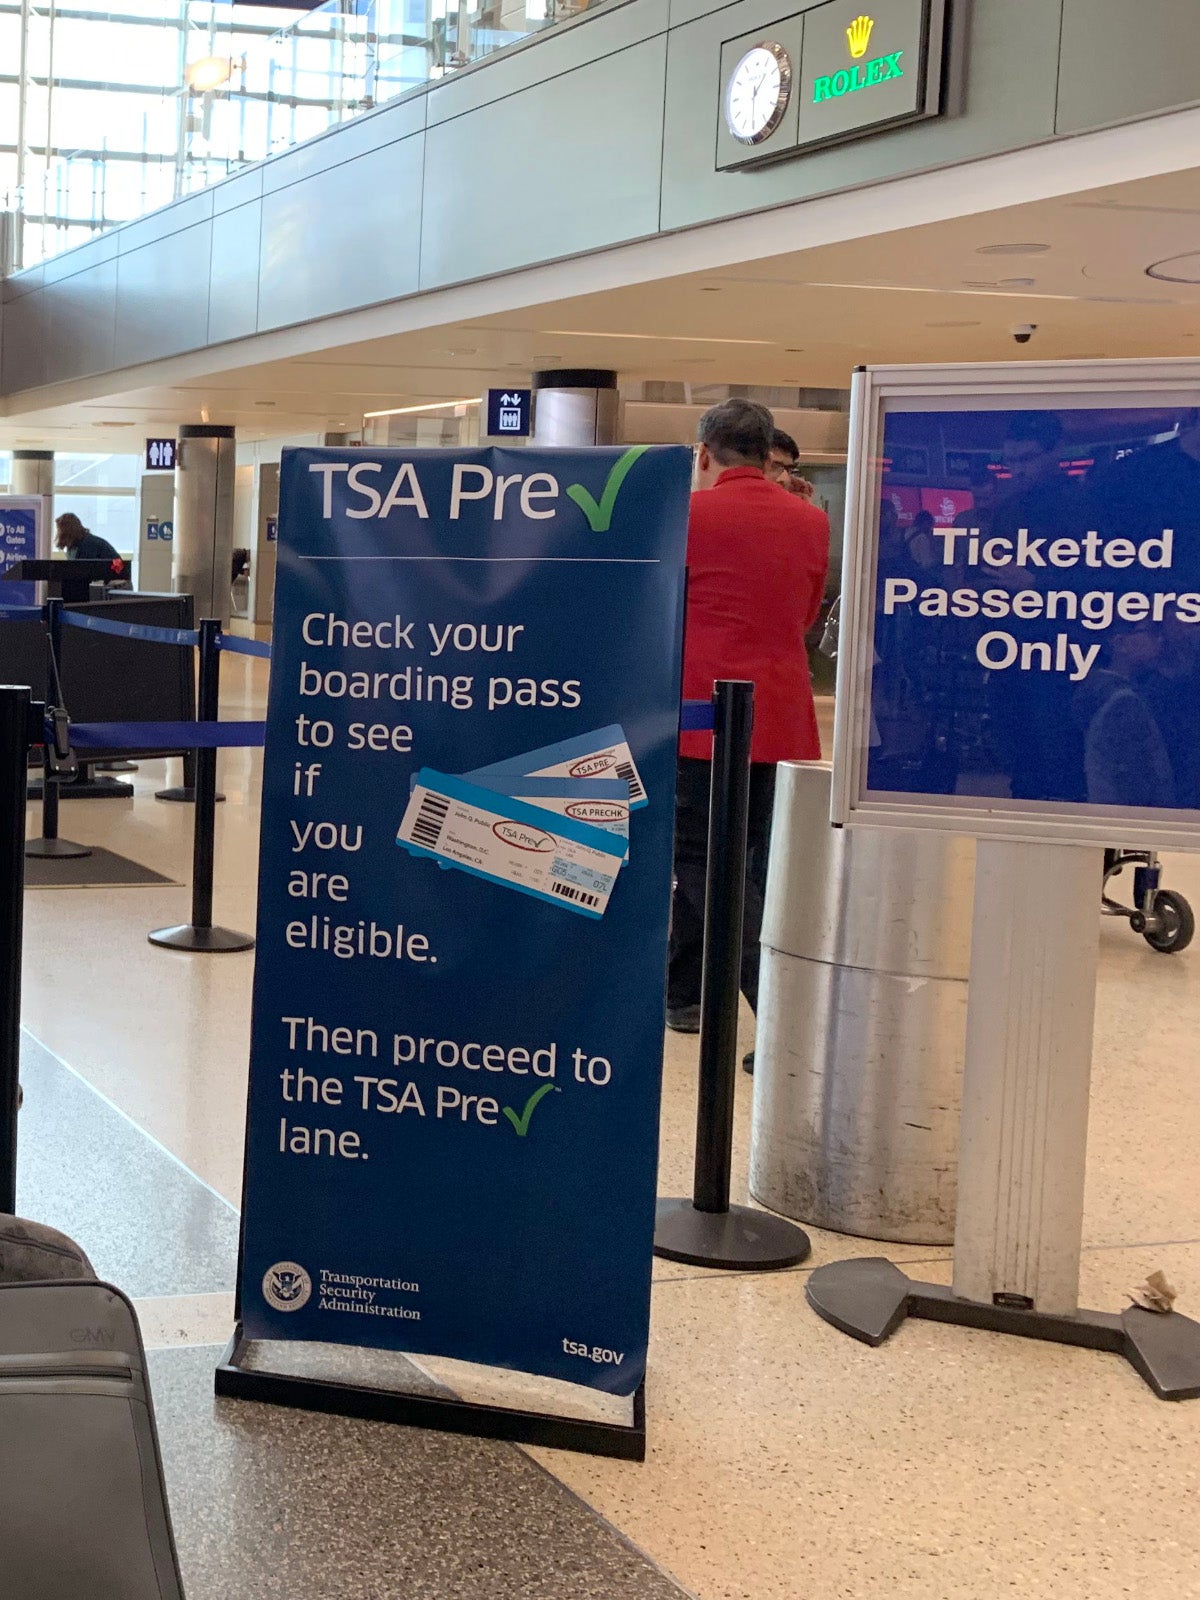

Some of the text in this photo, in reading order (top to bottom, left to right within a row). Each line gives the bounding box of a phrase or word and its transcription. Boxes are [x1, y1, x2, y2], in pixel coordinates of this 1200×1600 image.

[812, 51, 904, 104] ROLEX
[308, 462, 559, 521] TSA Pre
[5, 525, 25, 534] To All
[5, 536, 26, 545] Gates
[932, 527, 1174, 568] Ticketed
[884, 578, 1200, 630] Passengers
[302, 612, 524, 656] Check your
[976, 631, 1101, 681] Only
[299, 661, 581, 710] boarding pass
[294, 713, 413, 752] to see
[293, 762, 321, 797] if
[576, 758, 610, 775] TSA PRE
[571, 807, 623, 818] TSA PRECHK
[290, 820, 363, 852] you
[501, 826, 517, 839] TSA
[288, 870, 349, 902] are
[286, 915, 438, 963] eligible.
[281, 1017, 611, 1085] Then proceed to
[279, 1067, 499, 1125] the TSA Pre
[279, 1118, 369, 1160] lane.
[319, 1269, 420, 1293] Transportation
[319, 1283, 376, 1304] Security
[318, 1298, 422, 1321] Administration
[562, 1337, 625, 1366] tsa.gov
